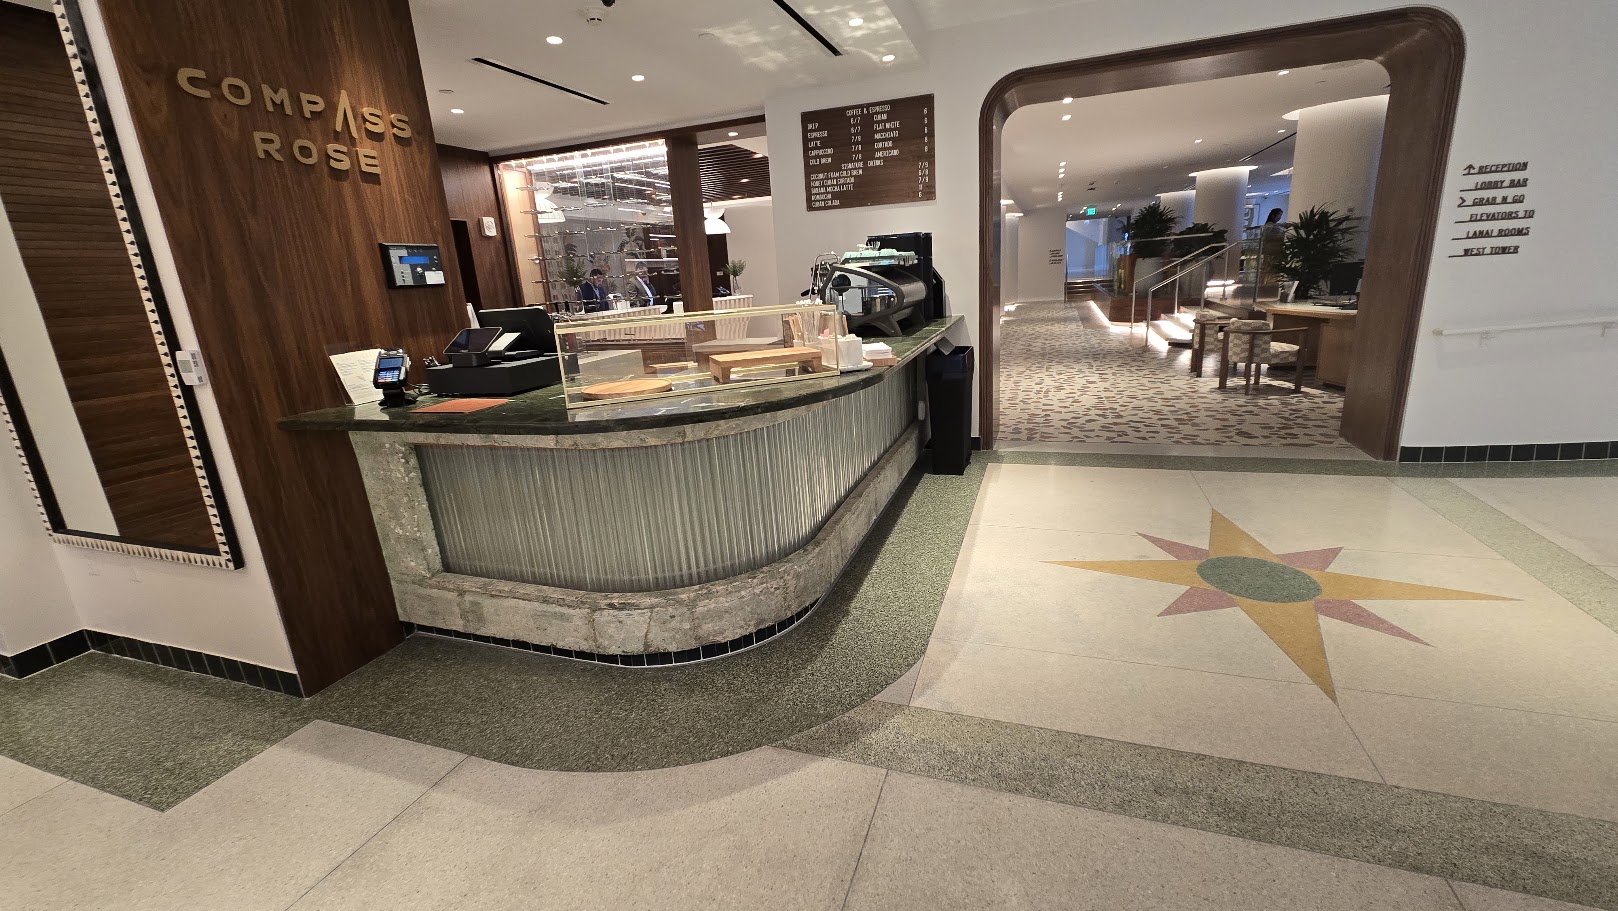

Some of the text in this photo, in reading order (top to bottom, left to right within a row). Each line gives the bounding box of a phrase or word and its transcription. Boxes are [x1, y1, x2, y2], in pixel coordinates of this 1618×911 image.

[176, 67, 412, 138] COMPASS
[846, 108, 862, 117] COFFEE
[869, 105, 891, 113] ESPRESSO
[874, 131, 898, 139] MACCHIATO
[253, 131, 381, 174] ROSE
[809, 148, 833, 156] CAPPUCCINO
[875, 149, 899, 158] AMERICANO
[1478, 161, 1528, 173] RECEPTION
[1475, 178, 1528, 189] LOBBY BAR
[1473, 197, 1497, 205] GRAB
[1512, 194, 1525, 203] GO
[1469, 210, 1535, 221] ELEVATORS TO
[1466, 227, 1530, 238] LANAI ROOMS
[1463, 246, 1520, 255] WEST TOWER
